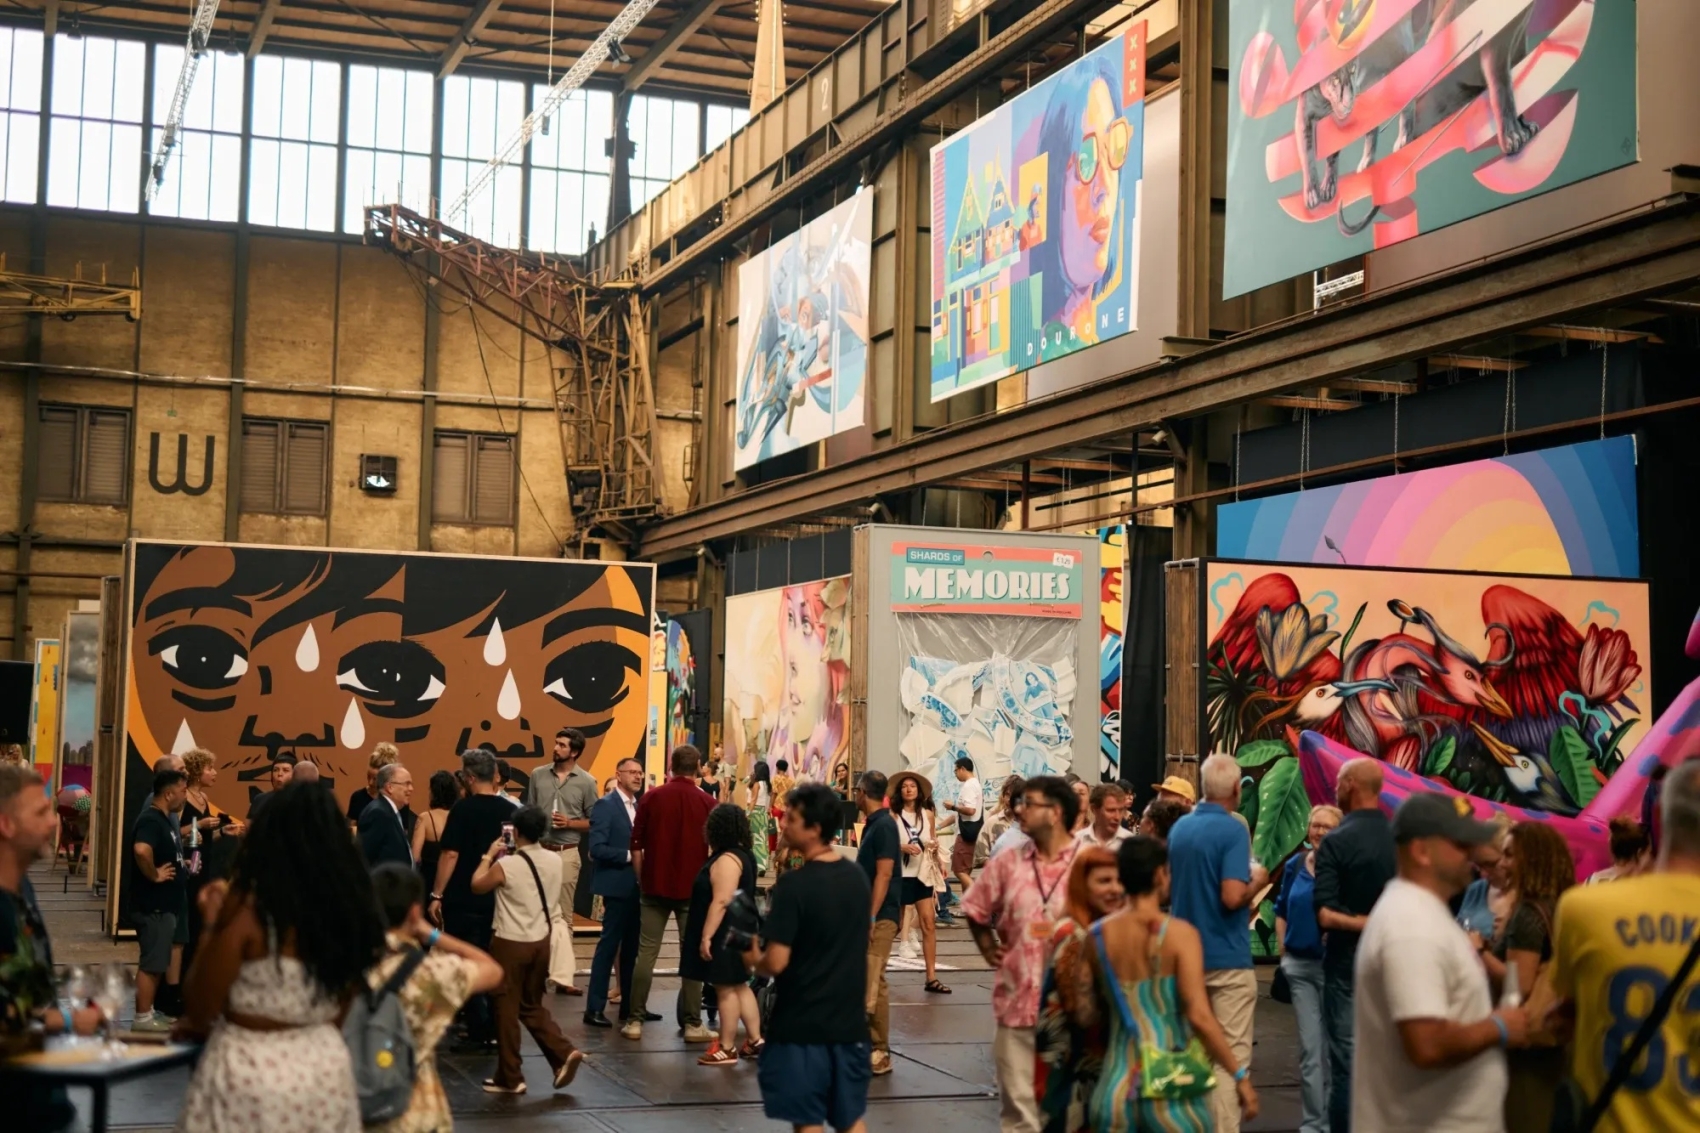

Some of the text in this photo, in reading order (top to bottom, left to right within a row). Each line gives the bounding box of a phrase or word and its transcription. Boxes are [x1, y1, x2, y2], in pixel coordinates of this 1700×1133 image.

[821, 77, 829, 111] 2
[1026, 306, 1125, 356] DOURONE
[910, 550, 962, 562] SHARDS OF
[904, 566, 1071, 601] MEMORIES
